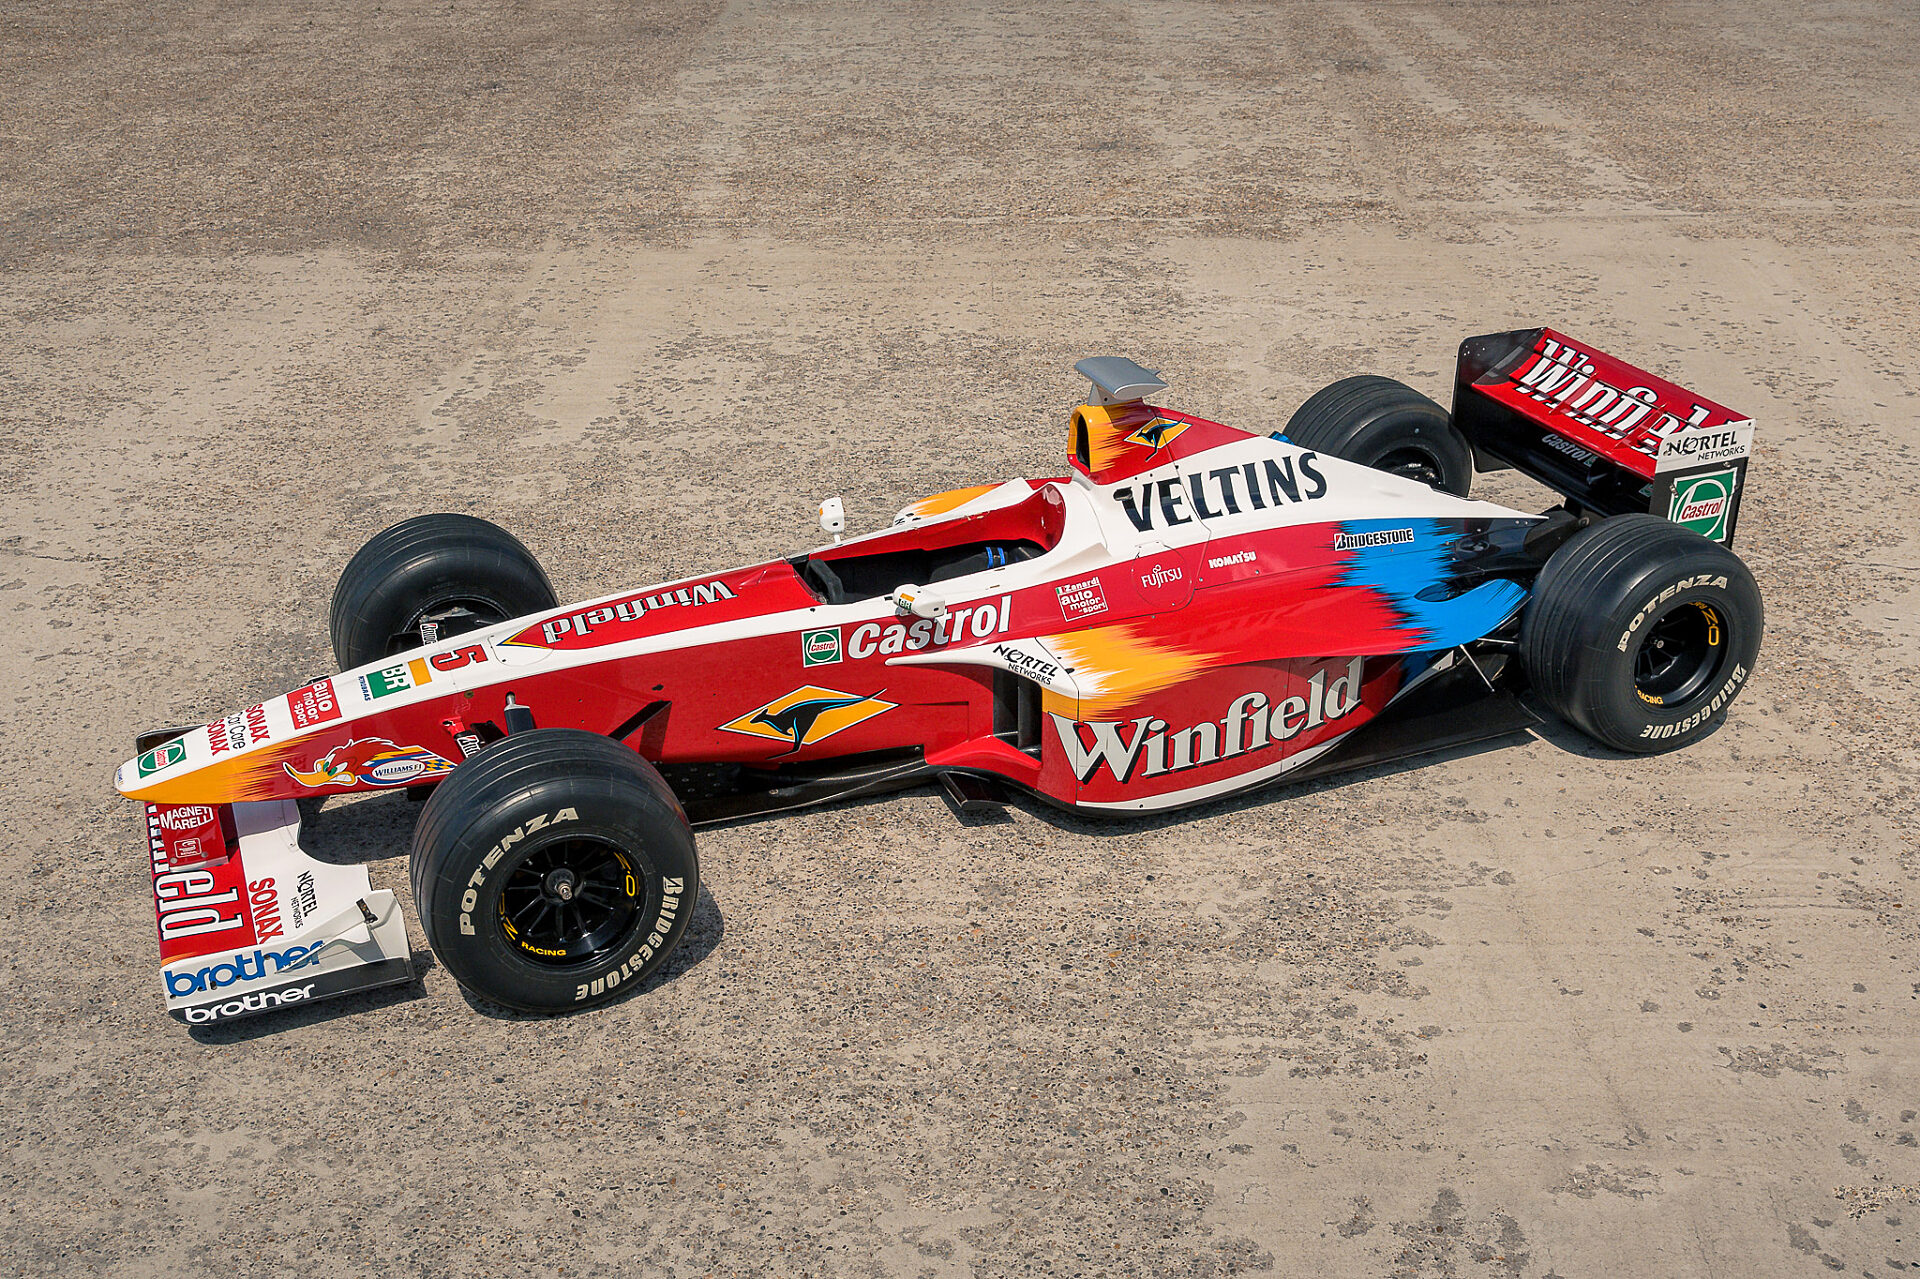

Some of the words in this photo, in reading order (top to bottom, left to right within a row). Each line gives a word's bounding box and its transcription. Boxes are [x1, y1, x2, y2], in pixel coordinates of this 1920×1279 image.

[1541, 433, 1592, 461] Castrol
[1666, 431, 1737, 455] NORTEL
[1698, 445, 1745, 461] NETWORKS
[1119, 452, 1328, 532] VELTINS
[1681, 499, 1722, 521] Castrol
[1336, 530, 1413, 549] BRIDGESTONE
[1209, 551, 1257, 569] KOMATSU
[1141, 565, 1182, 588] FUJITSU
[541, 580, 738, 644] Winfield
[1061, 590, 1093, 605] auto
[1070, 597, 1100, 610] motor
[848, 595, 1012, 659] Castrol
[1617, 574, 1728, 653] POTENZA
[430, 644, 488, 671] 5
[811, 641, 836, 652] Castrol
[993, 644, 1058, 677] NORTEL
[382, 665, 409, 690] BR
[1008, 663, 1051, 685] NETWORKS
[303, 692, 319, 721] motor
[313, 682, 332, 712] auto
[1637, 689, 1664, 705] RACING
[1640, 663, 1747, 739] BRIDGESTONE
[245, 703, 270, 744] SONAX
[1048, 655, 1364, 783] Winfield
[207, 719, 230, 756] SONAX
[230, 725, 246, 749] Care
[375, 765, 413, 776] WILLIAMS
[459, 807, 579, 936] POTENZA
[297, 870, 318, 917] NORTEL
[249, 878, 283, 944] SONAX
[290, 898, 303, 928] NETWORKS
[521, 940, 567, 957] RACING
[575, 876, 684, 1000] BRIDGESTONE
[164, 940, 324, 997] brother
[185, 984, 315, 1022] brother
